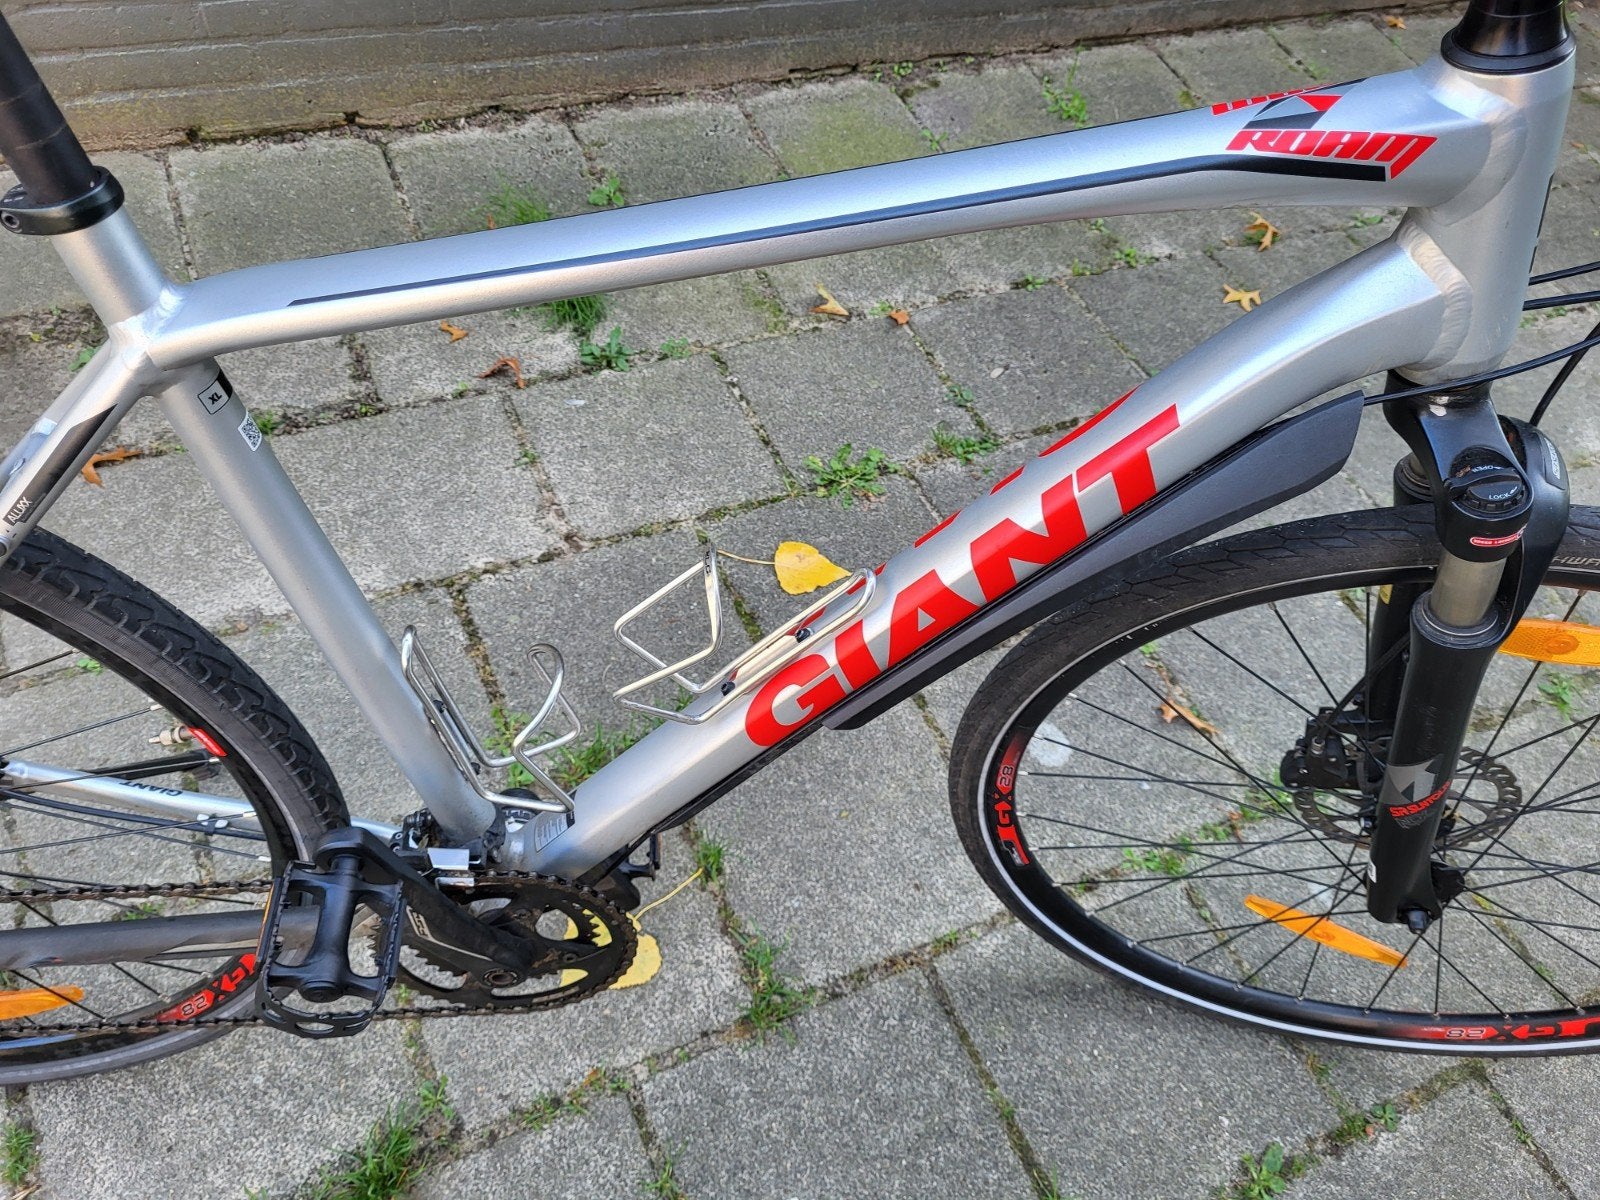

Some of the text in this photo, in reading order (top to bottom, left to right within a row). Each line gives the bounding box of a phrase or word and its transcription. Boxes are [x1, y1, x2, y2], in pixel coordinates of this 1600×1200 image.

[1225, 129, 1438, 181] ROAM
[207, 391, 223, 406] XL
[1488, 492, 1511, 501] LOCK
[744, 403, 1180, 748] GIANT
[118, 780, 184, 797] GIANT
